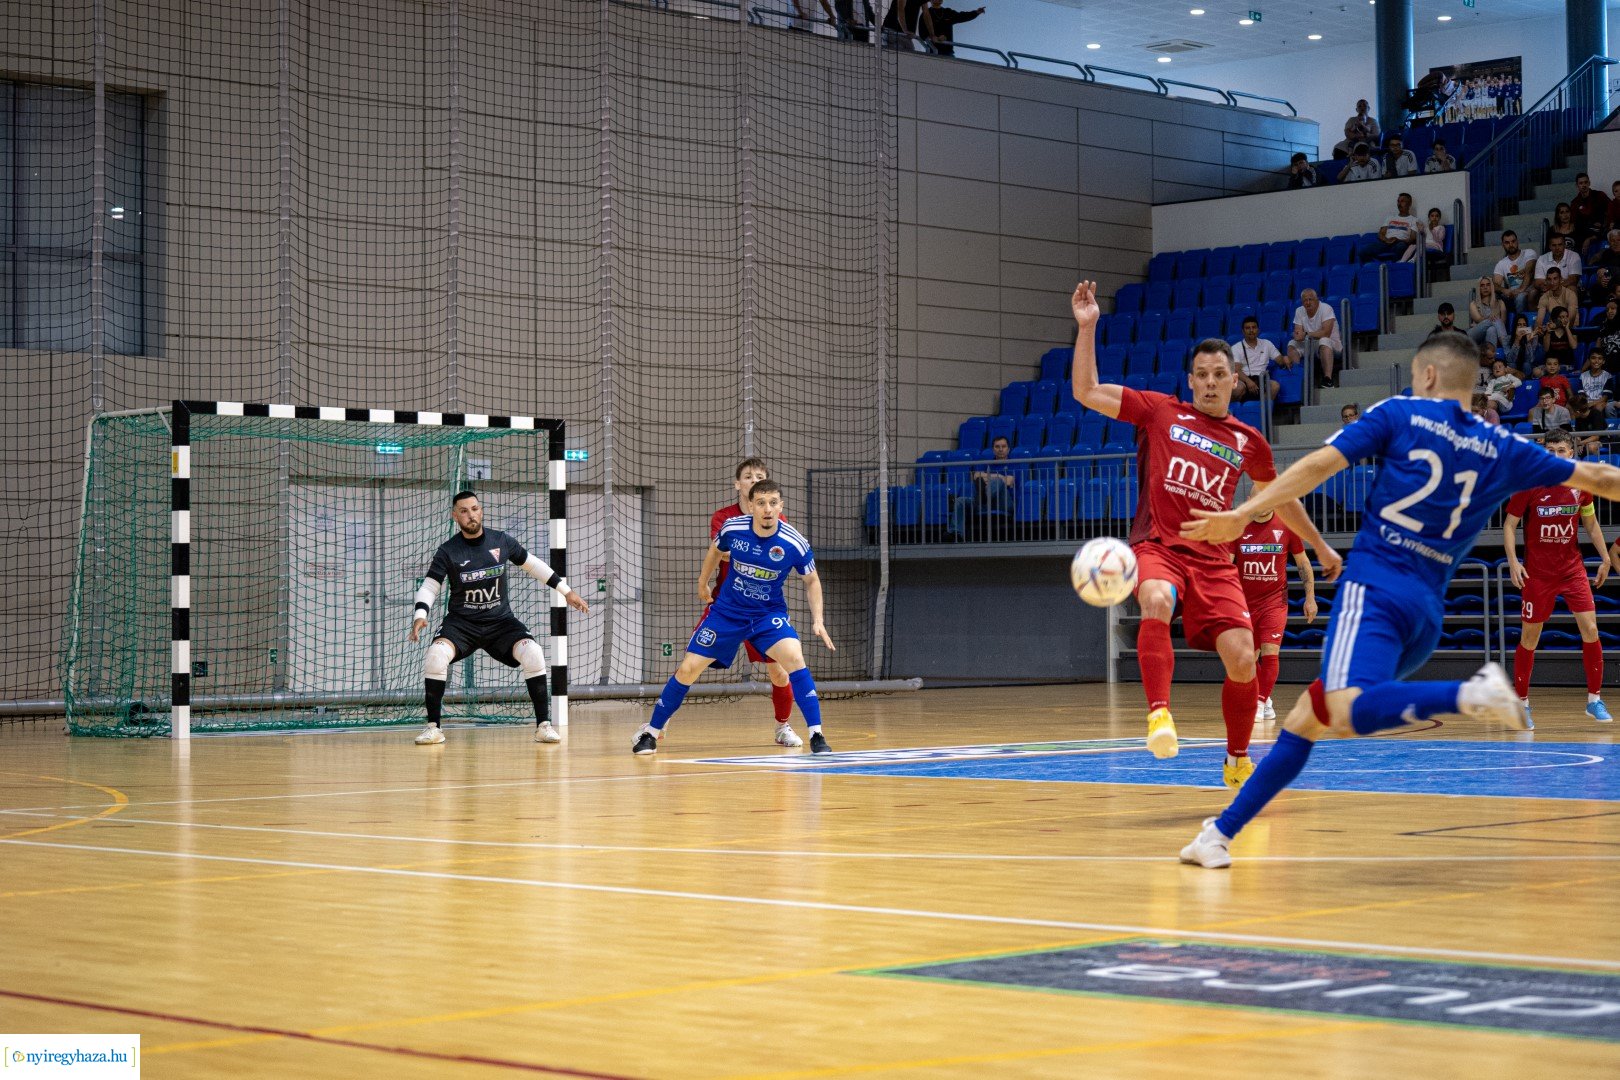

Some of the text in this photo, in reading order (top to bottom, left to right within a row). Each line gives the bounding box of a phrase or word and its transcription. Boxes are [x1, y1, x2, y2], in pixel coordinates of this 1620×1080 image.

[1167, 456, 1230, 501] mvl
[1379, 449, 1478, 539] 21
[731, 538, 750, 552] 383
[1244, 555, 1277, 574] mvl
[465, 578, 501, 602] mvl
